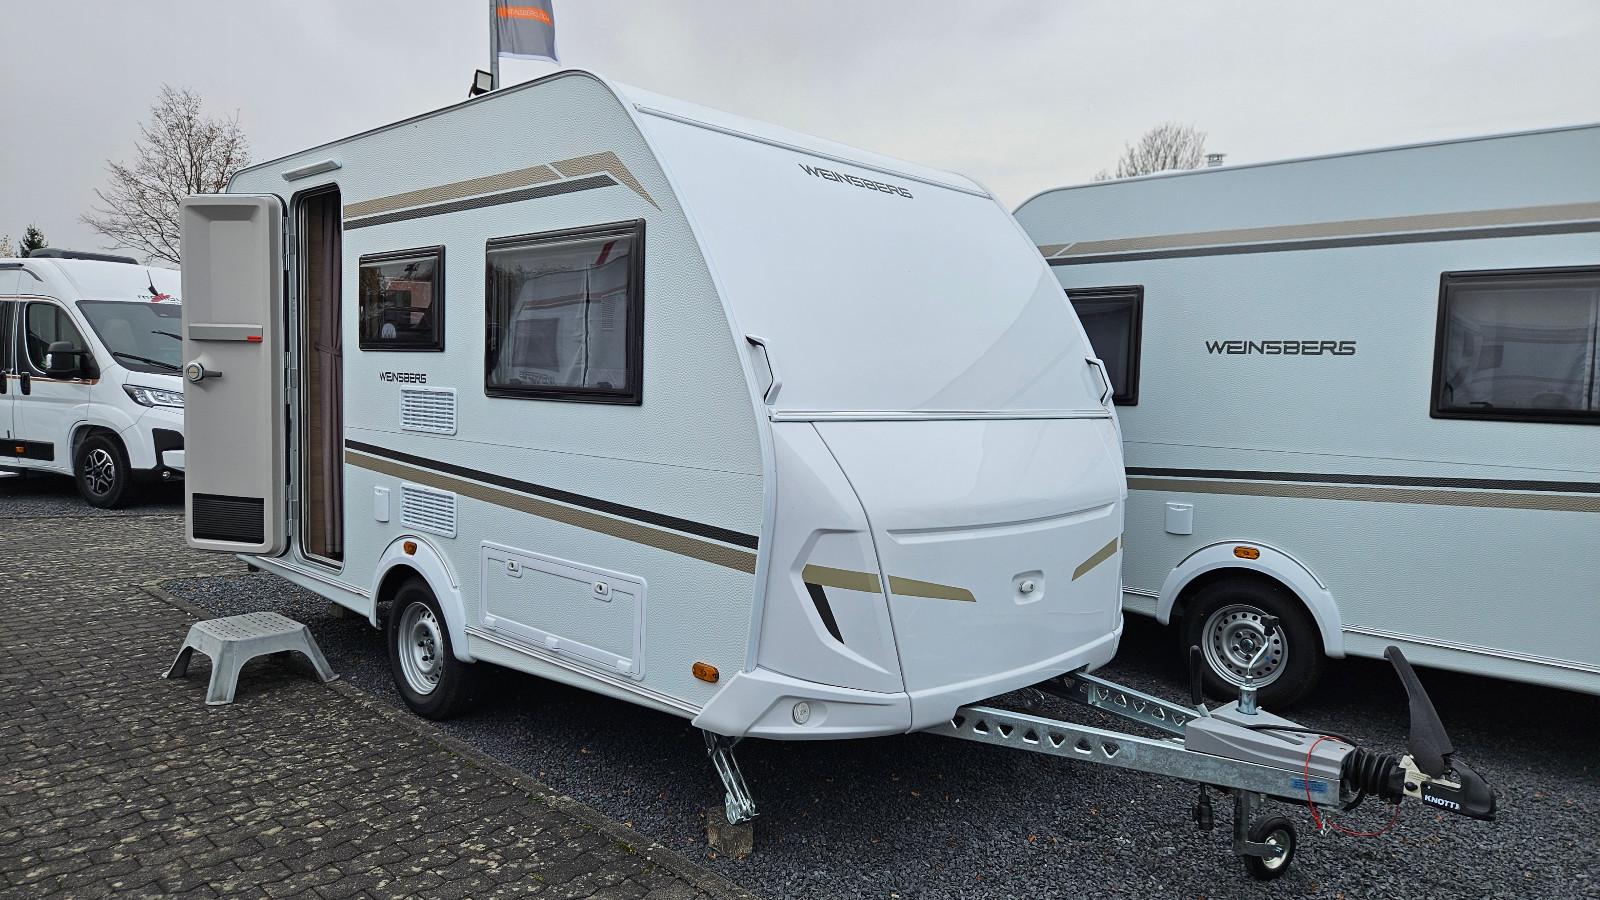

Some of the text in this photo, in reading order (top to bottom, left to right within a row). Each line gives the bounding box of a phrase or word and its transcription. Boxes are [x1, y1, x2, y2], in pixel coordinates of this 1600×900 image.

[798, 163, 914, 199] WEINSBERG
[1205, 340, 1357, 356] WEINSBERG
[379, 371, 427, 384] WEINSBERG
